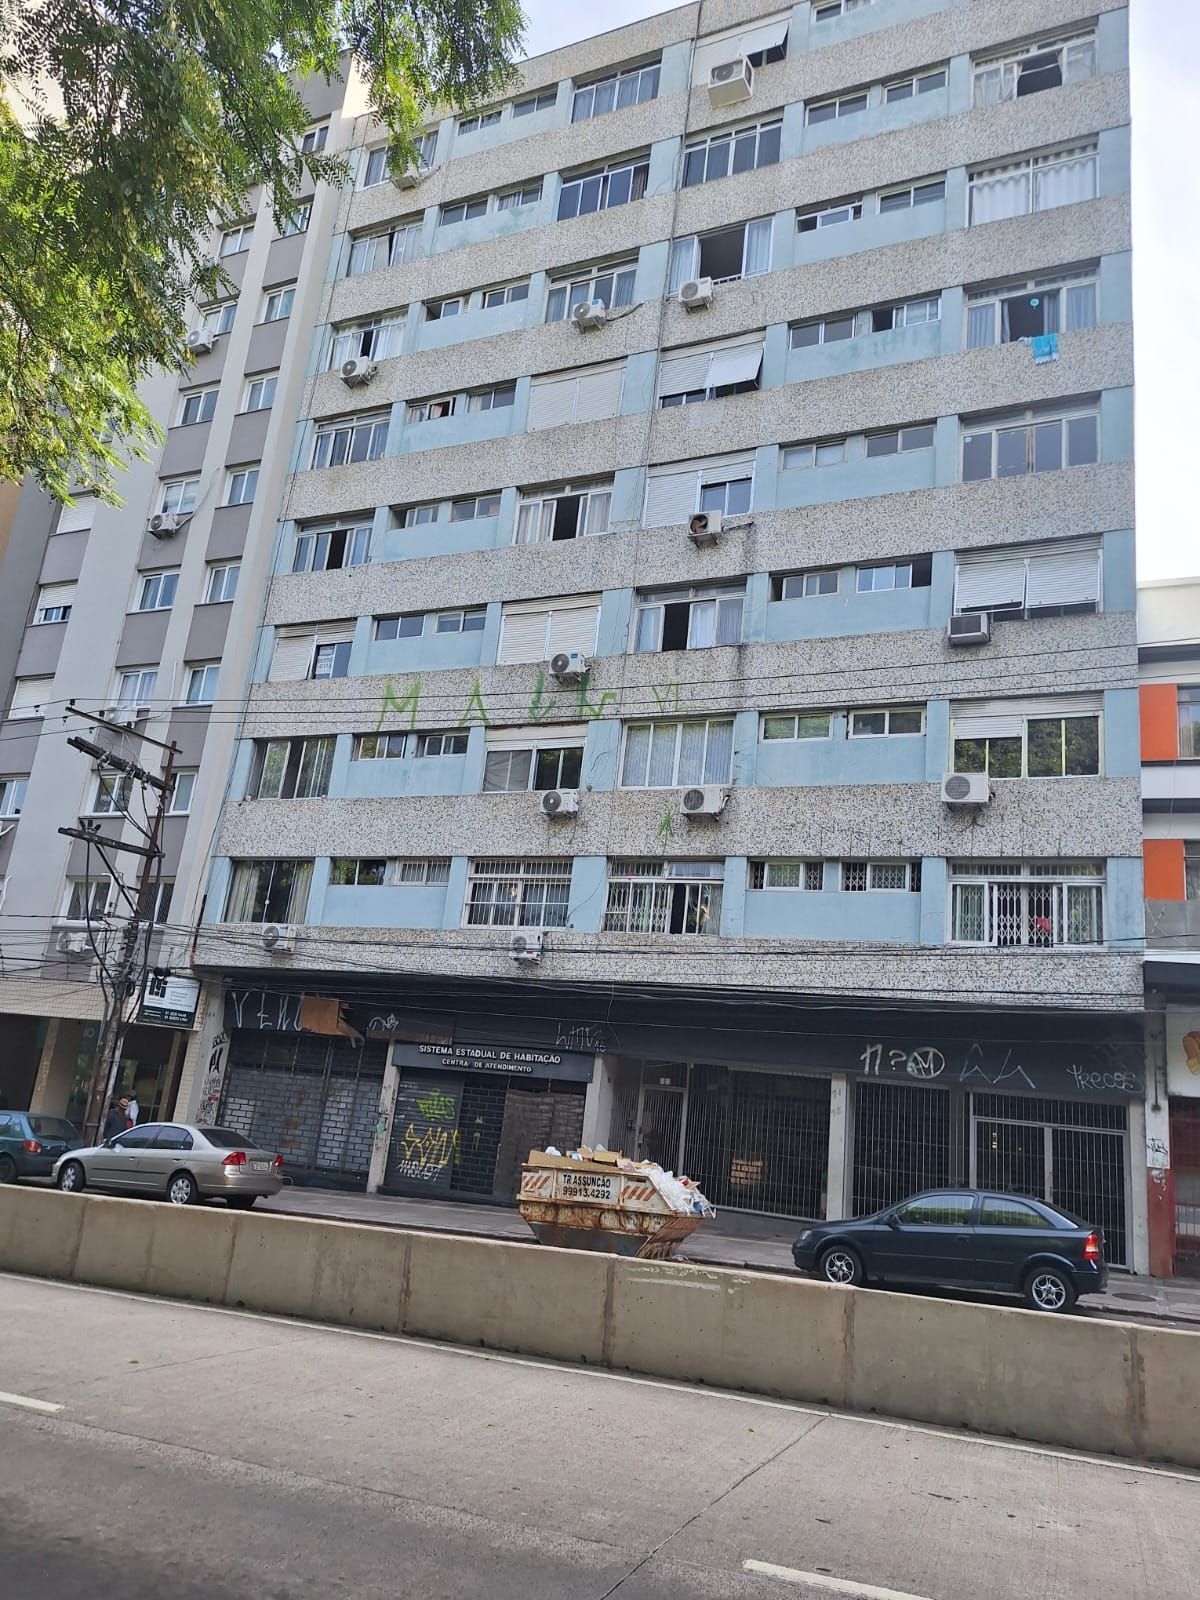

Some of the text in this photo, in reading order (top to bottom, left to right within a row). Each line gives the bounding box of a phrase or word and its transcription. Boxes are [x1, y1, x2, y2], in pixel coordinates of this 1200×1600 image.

[419, 1045, 453, 1055] SISTEMA
[456, 1048, 497, 1059] ESTADUAL
[500, 1051, 511, 1060] DE
[474, 1061, 483, 1069] DE
[485, 1062, 532, 1073] ATENDIMENTO
[563, 1174, 571, 1185] TR
[562, 1185, 611, 1200] 99913.4292
